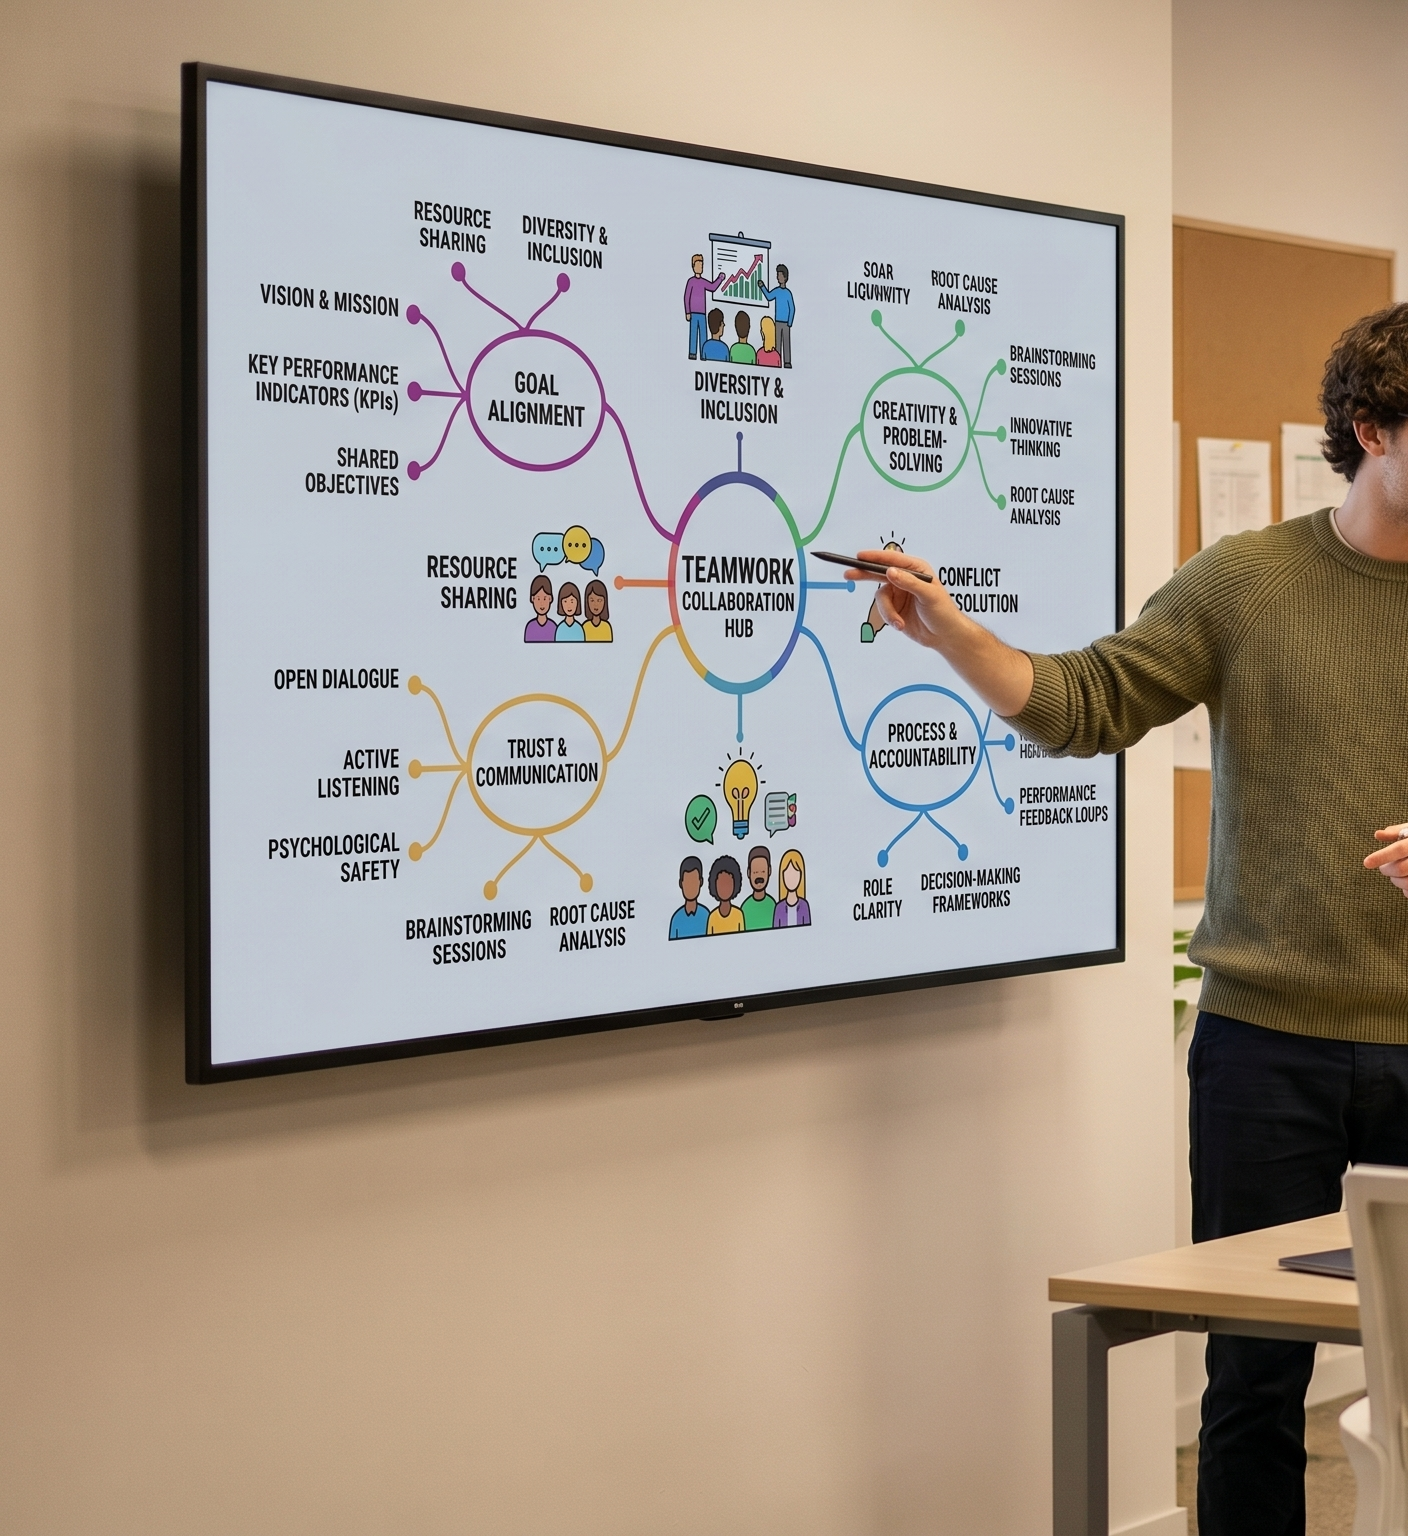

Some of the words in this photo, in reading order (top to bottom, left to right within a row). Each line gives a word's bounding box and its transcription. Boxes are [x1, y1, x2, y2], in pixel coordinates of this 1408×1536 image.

[414, 200, 492, 230] RESOURCE
[419, 227, 486, 254] SHARING
[522, 214, 596, 244] DIVERSITY
[598, 226, 608, 246] &
[527, 241, 603, 270] INCLUSION
[863, 260, 894, 281] SOAR
[931, 269, 961, 290] ROOT
[962, 274, 998, 295] CAUSE
[260, 283, 314, 309] VISION
[318, 289, 330, 310] &
[334, 291, 399, 317] MISSION
[937, 292, 991, 316] ANALYSIS
[248, 353, 279, 376] KEY
[283, 356, 399, 386] PERFORMANCE
[1010, 344, 1096, 371] BRAINSTORMING
[514, 370, 560, 397] GOAL
[694, 370, 771, 397] DIVERSITY
[773, 376, 784, 399] &
[1009, 366, 1062, 388] SESSIONS
[256, 380, 350, 408] INDICATORS
[353, 386, 399, 416] (KPIs)
[487, 399, 586, 428] ALIGNMENT
[700, 398, 778, 425] INCLUSION
[873, 399, 947, 425] CREATIVITY
[948, 406, 958, 426] &
[883, 425, 947, 449] PROBLEM-
[1010, 416, 1073, 438] INNOVATIVE
[337, 446, 399, 470] SHARED
[1009, 438, 1061, 458] THINKING
[889, 450, 943, 474] SOLVING
[305, 472, 399, 497] OBJECTIVES
[1010, 485, 1039, 504] ROOT
[1041, 487, 1075, 506] CAUSE
[1009, 507, 1061, 526] ANALYSIS
[427, 554, 518, 580] RESOURCE
[681, 555, 795, 585] TEAMWORK
[938, 566, 1001, 588] CONFLICT
[440, 585, 517, 610] SHARING
[682, 590, 795, 612] COLLABORATION
[949, 592, 1018, 613] SOLUTION
[725, 618, 754, 638] HUB
[274, 668, 318, 690] OPEN
[322, 668, 400, 689] DIALOGUE
[888, 721, 946, 743] PROCESS
[948, 721, 958, 741] &
[343, 748, 400, 770] ACTIVE
[507, 737, 555, 759] TRUST
[557, 737, 568, 757] &
[868, 745, 977, 769] ACCOUNTABILITY
[317, 775, 400, 799] LISTENING
[475, 762, 598, 788] COMMUNICATION
[1019, 784, 1097, 805] PERFORMANCE
[1019, 807, 1074, 827] FEEDBACK
[1075, 805, 1109, 823] LOUPS
[268, 831, 400, 860] PSYCHOLOGICAL
[340, 858, 401, 883] SAFETY
[921, 866, 1021, 891] DECISION-MAKING
[863, 877, 893, 898] ROLE
[550, 903, 588, 927] ROOT
[590, 899, 636, 923] CAUSE
[853, 899, 903, 922] CLARITY
[932, 889, 1011, 914] FRAMEWORKS
[405, 909, 532, 941] BRAINSTORMING
[432, 938, 507, 966] SESSIONS
[558, 926, 626, 953] ANALYSIS
